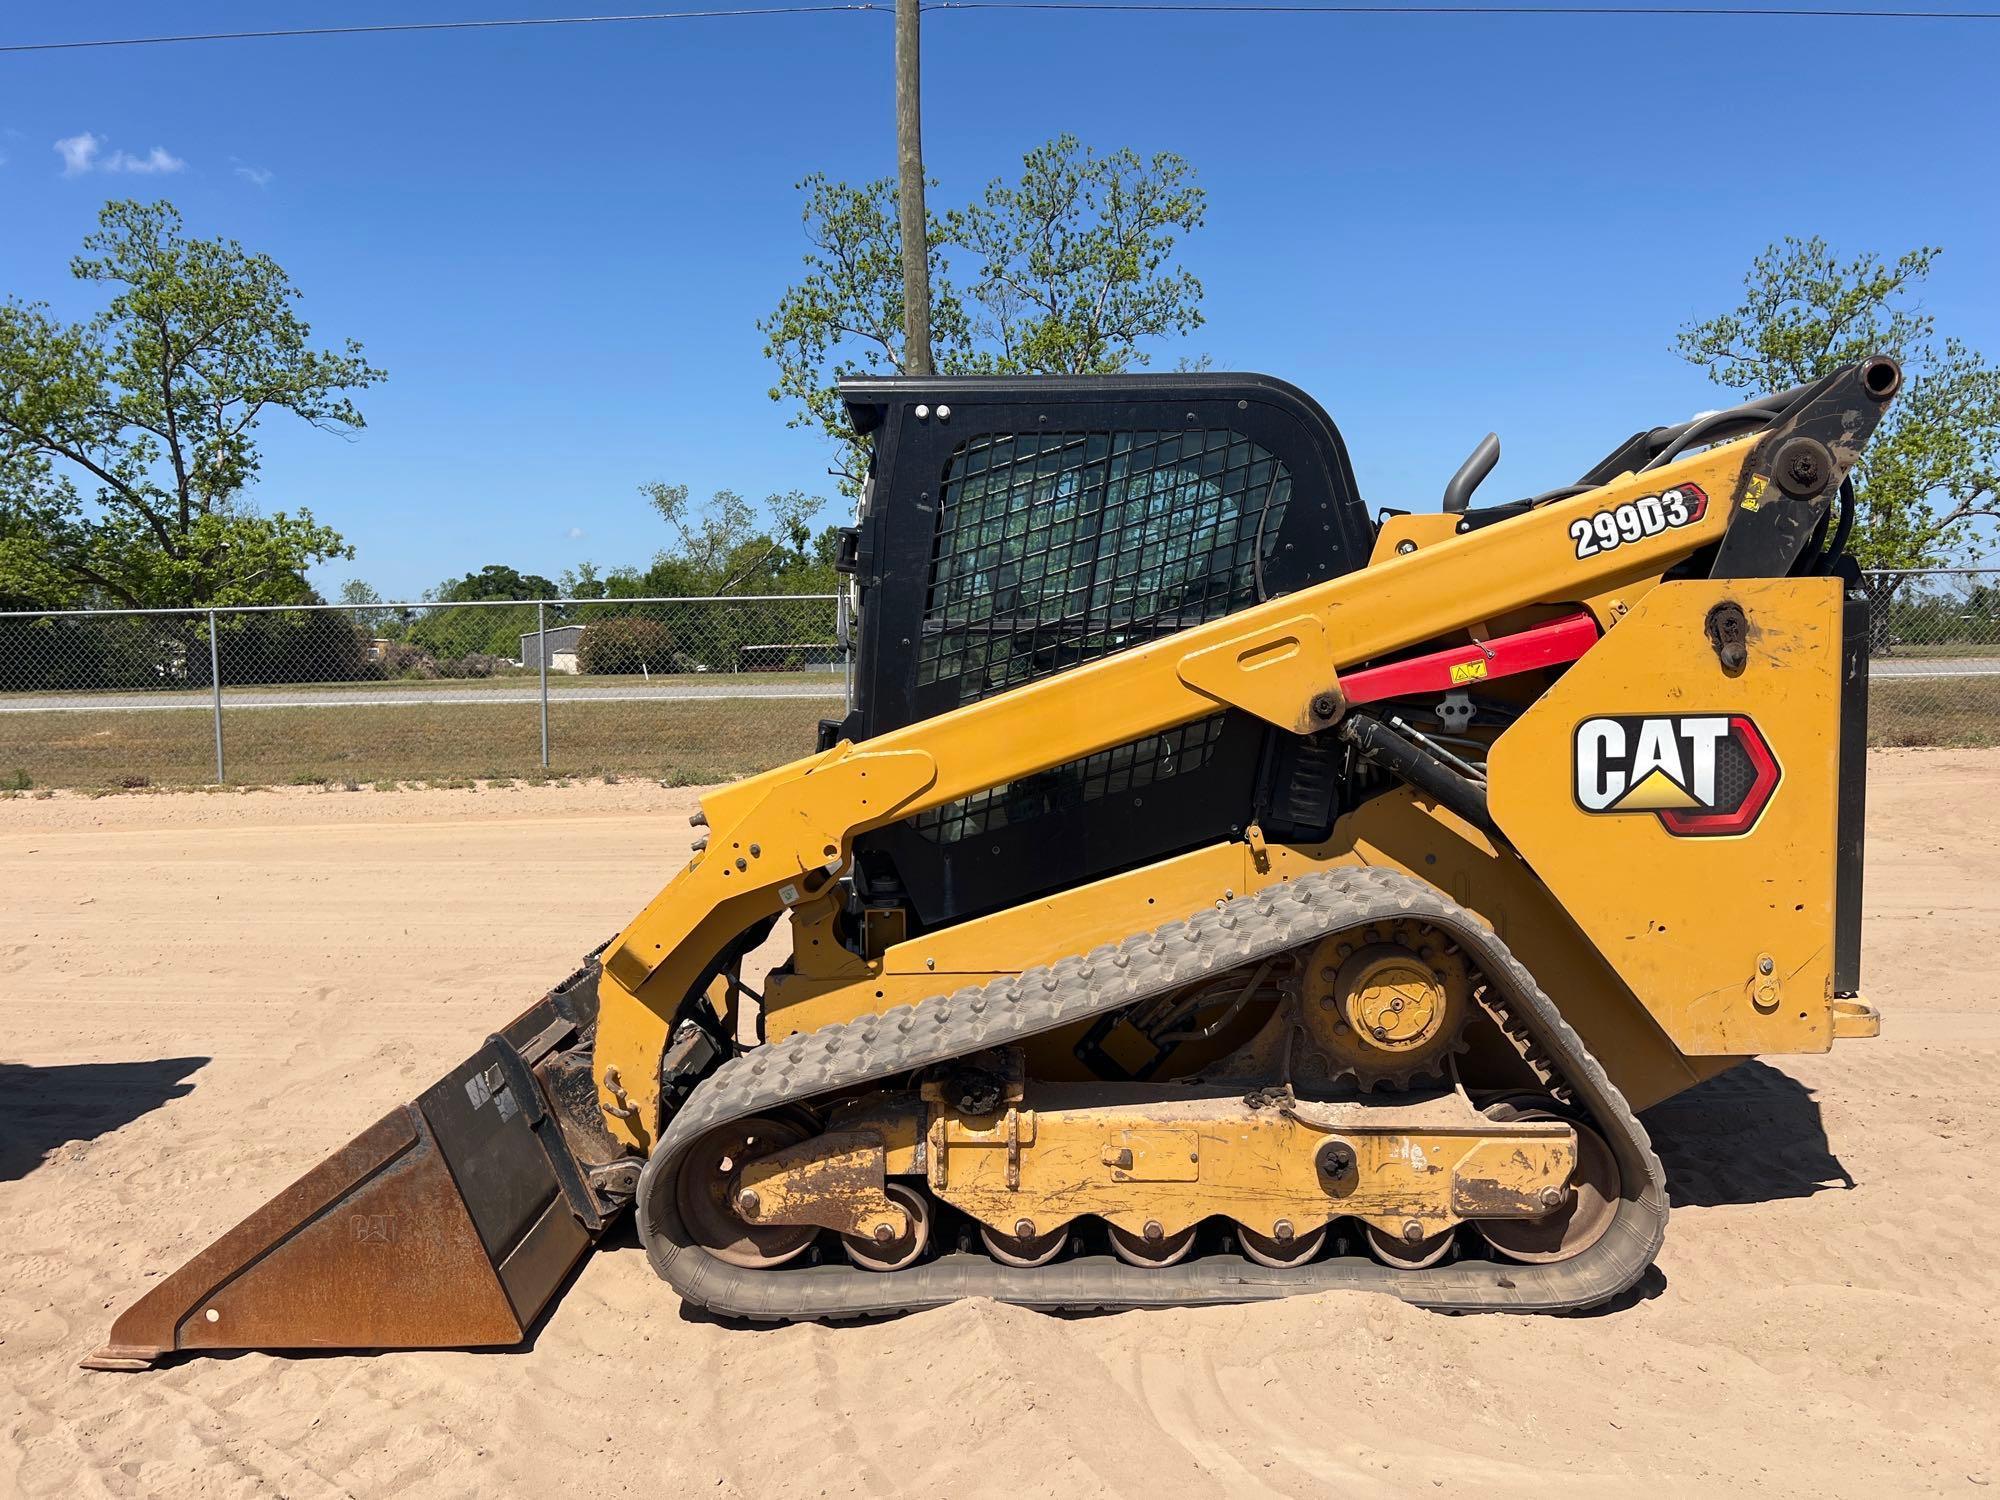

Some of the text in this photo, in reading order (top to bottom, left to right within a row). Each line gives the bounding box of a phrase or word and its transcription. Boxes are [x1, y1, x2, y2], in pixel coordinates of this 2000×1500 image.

[1570, 490, 1689, 558] 299D3
[1577, 717, 1729, 810] CAT
[350, 1214, 398, 1243] CAT
